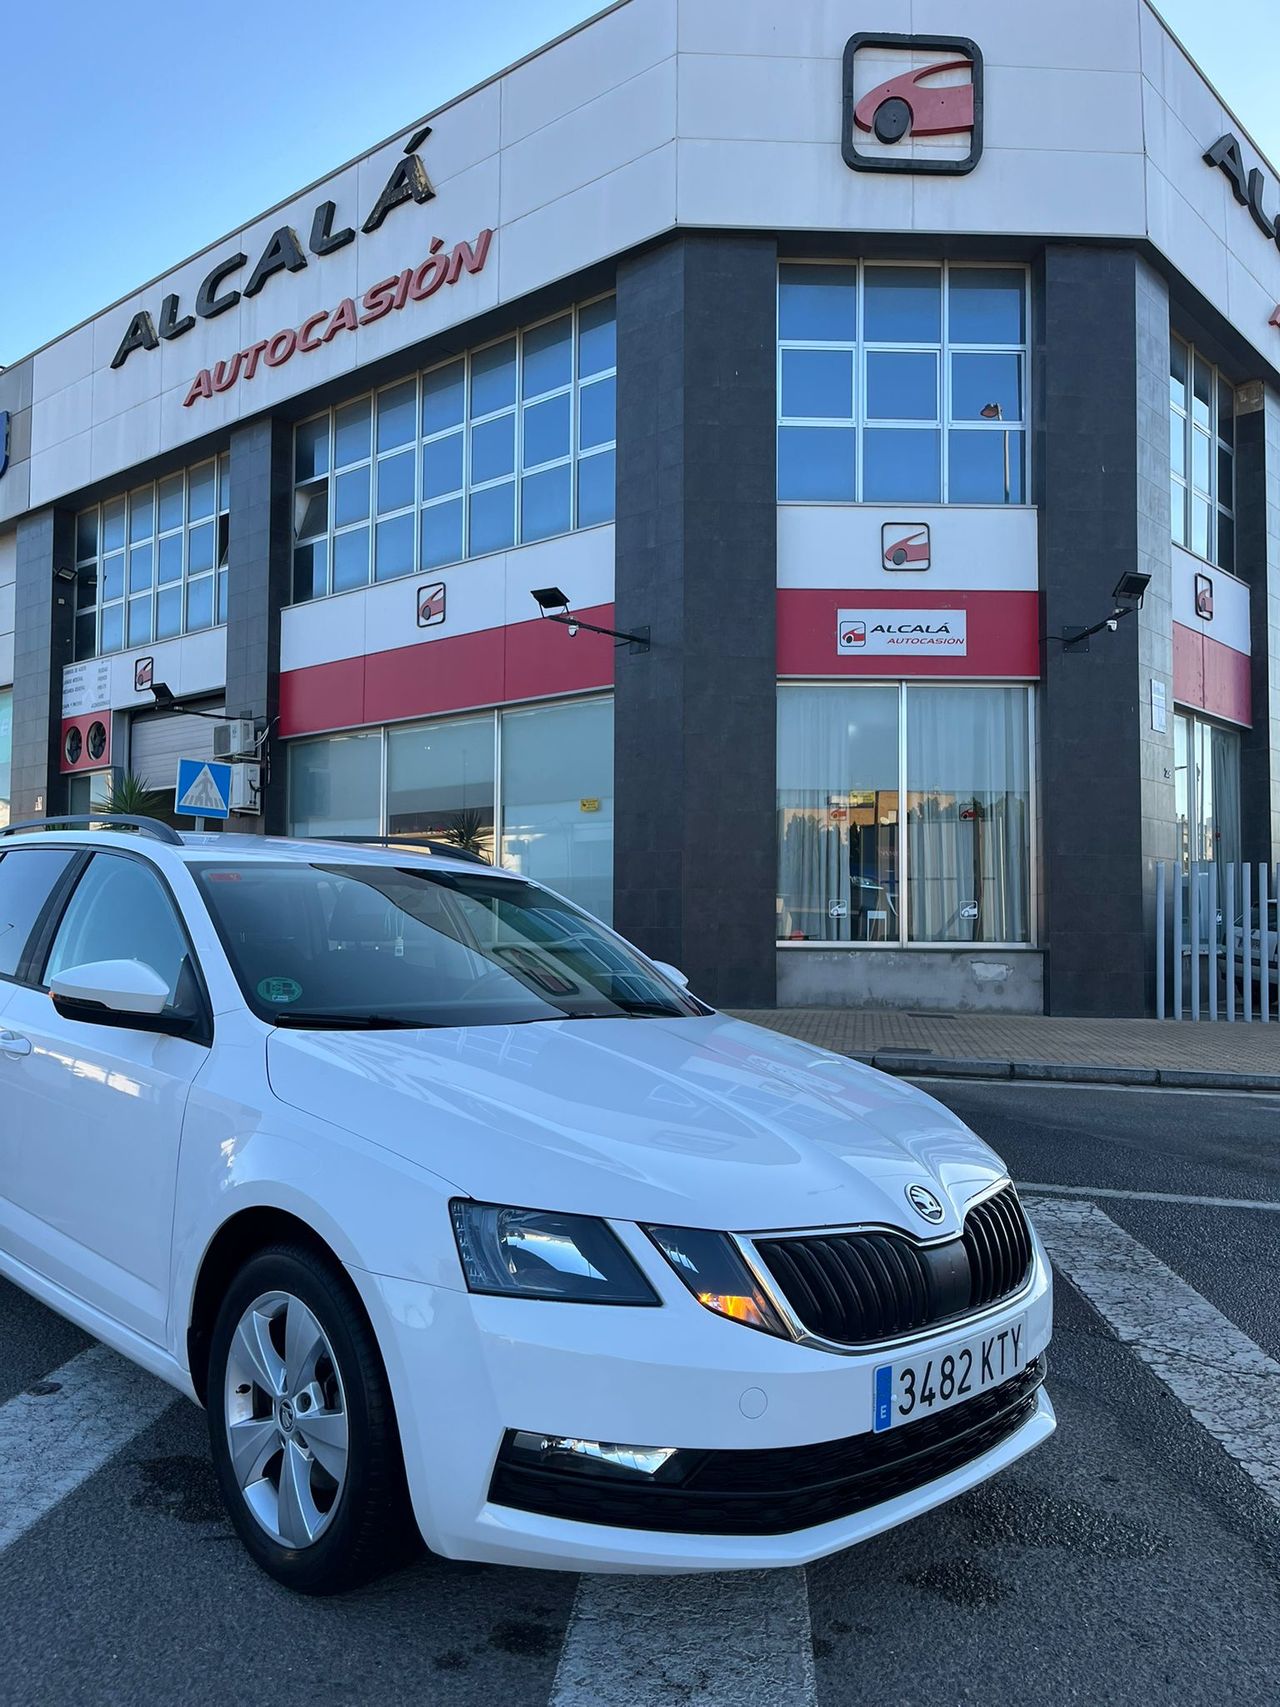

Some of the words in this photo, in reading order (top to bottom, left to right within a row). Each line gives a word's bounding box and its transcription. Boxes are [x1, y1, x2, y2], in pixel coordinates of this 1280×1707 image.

[1202, 132, 1280, 253] AL
[110, 126, 436, 369] ALCALÁ
[182, 228, 493, 408] AUTOCASIÓN
[870, 622, 950, 634] ALCALÁ
[887, 636, 964, 645] AUTOCASIÓN
[880, 1404, 887, 1419] E
[898, 1348, 973, 1416] 3482
[980, 1323, 1022, 1385] KTY
